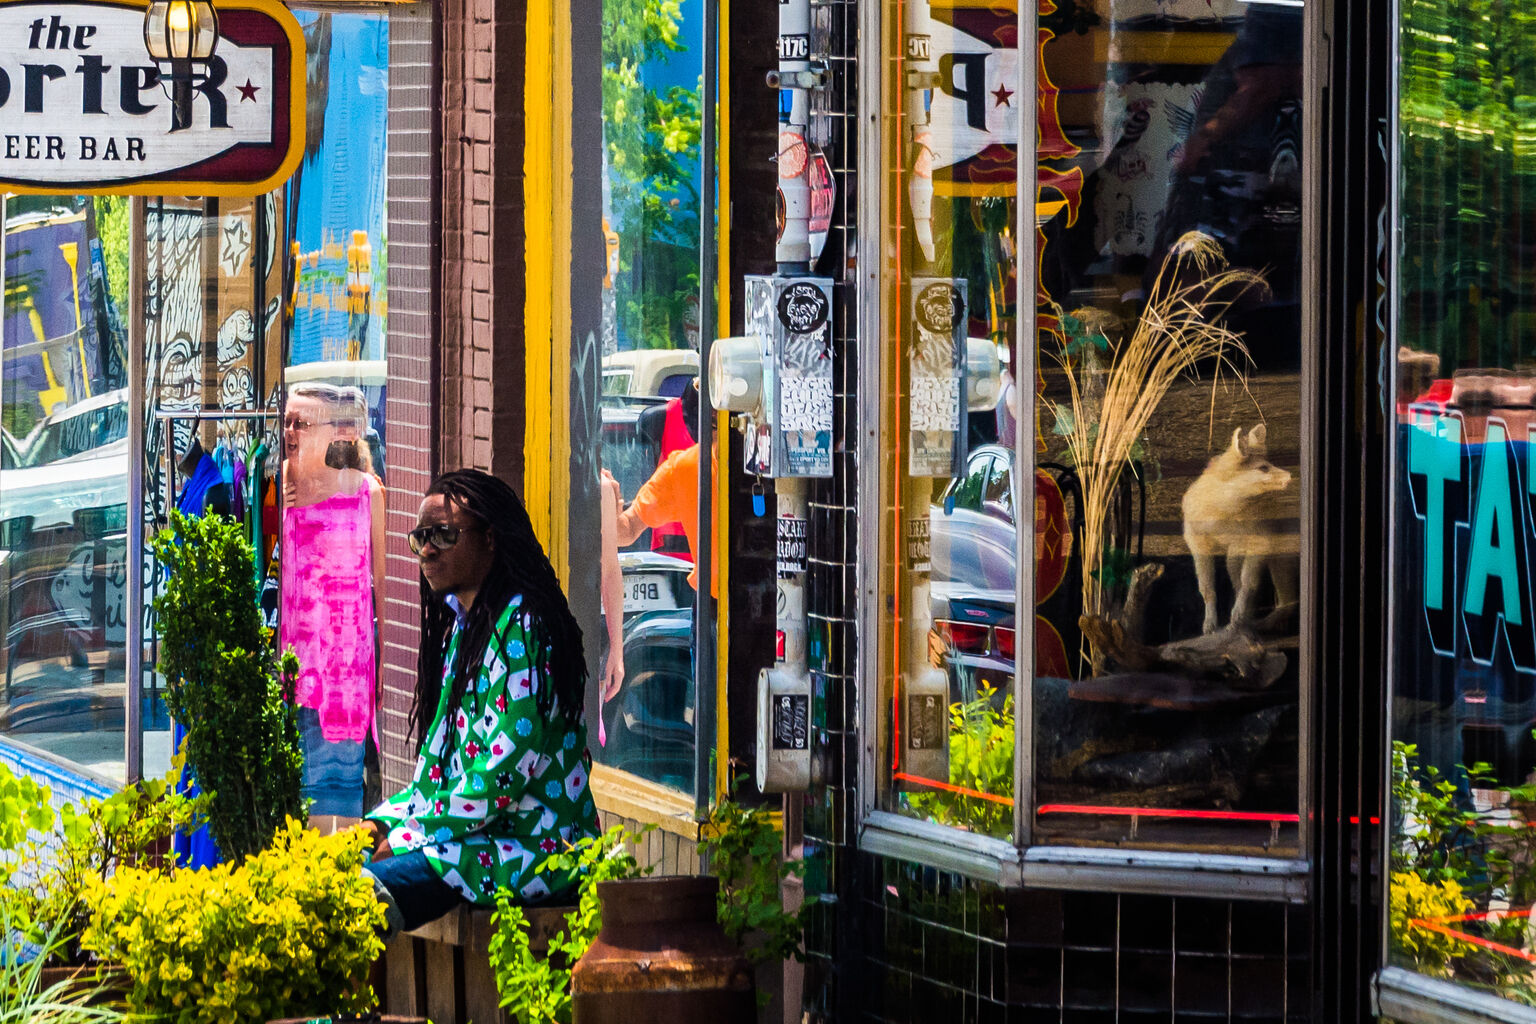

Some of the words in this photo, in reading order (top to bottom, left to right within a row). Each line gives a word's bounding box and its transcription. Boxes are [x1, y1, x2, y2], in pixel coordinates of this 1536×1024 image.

[28, 15, 97, 50] the
[79, 136, 147, 162] BAR
[1408, 406, 1536, 656] TA
